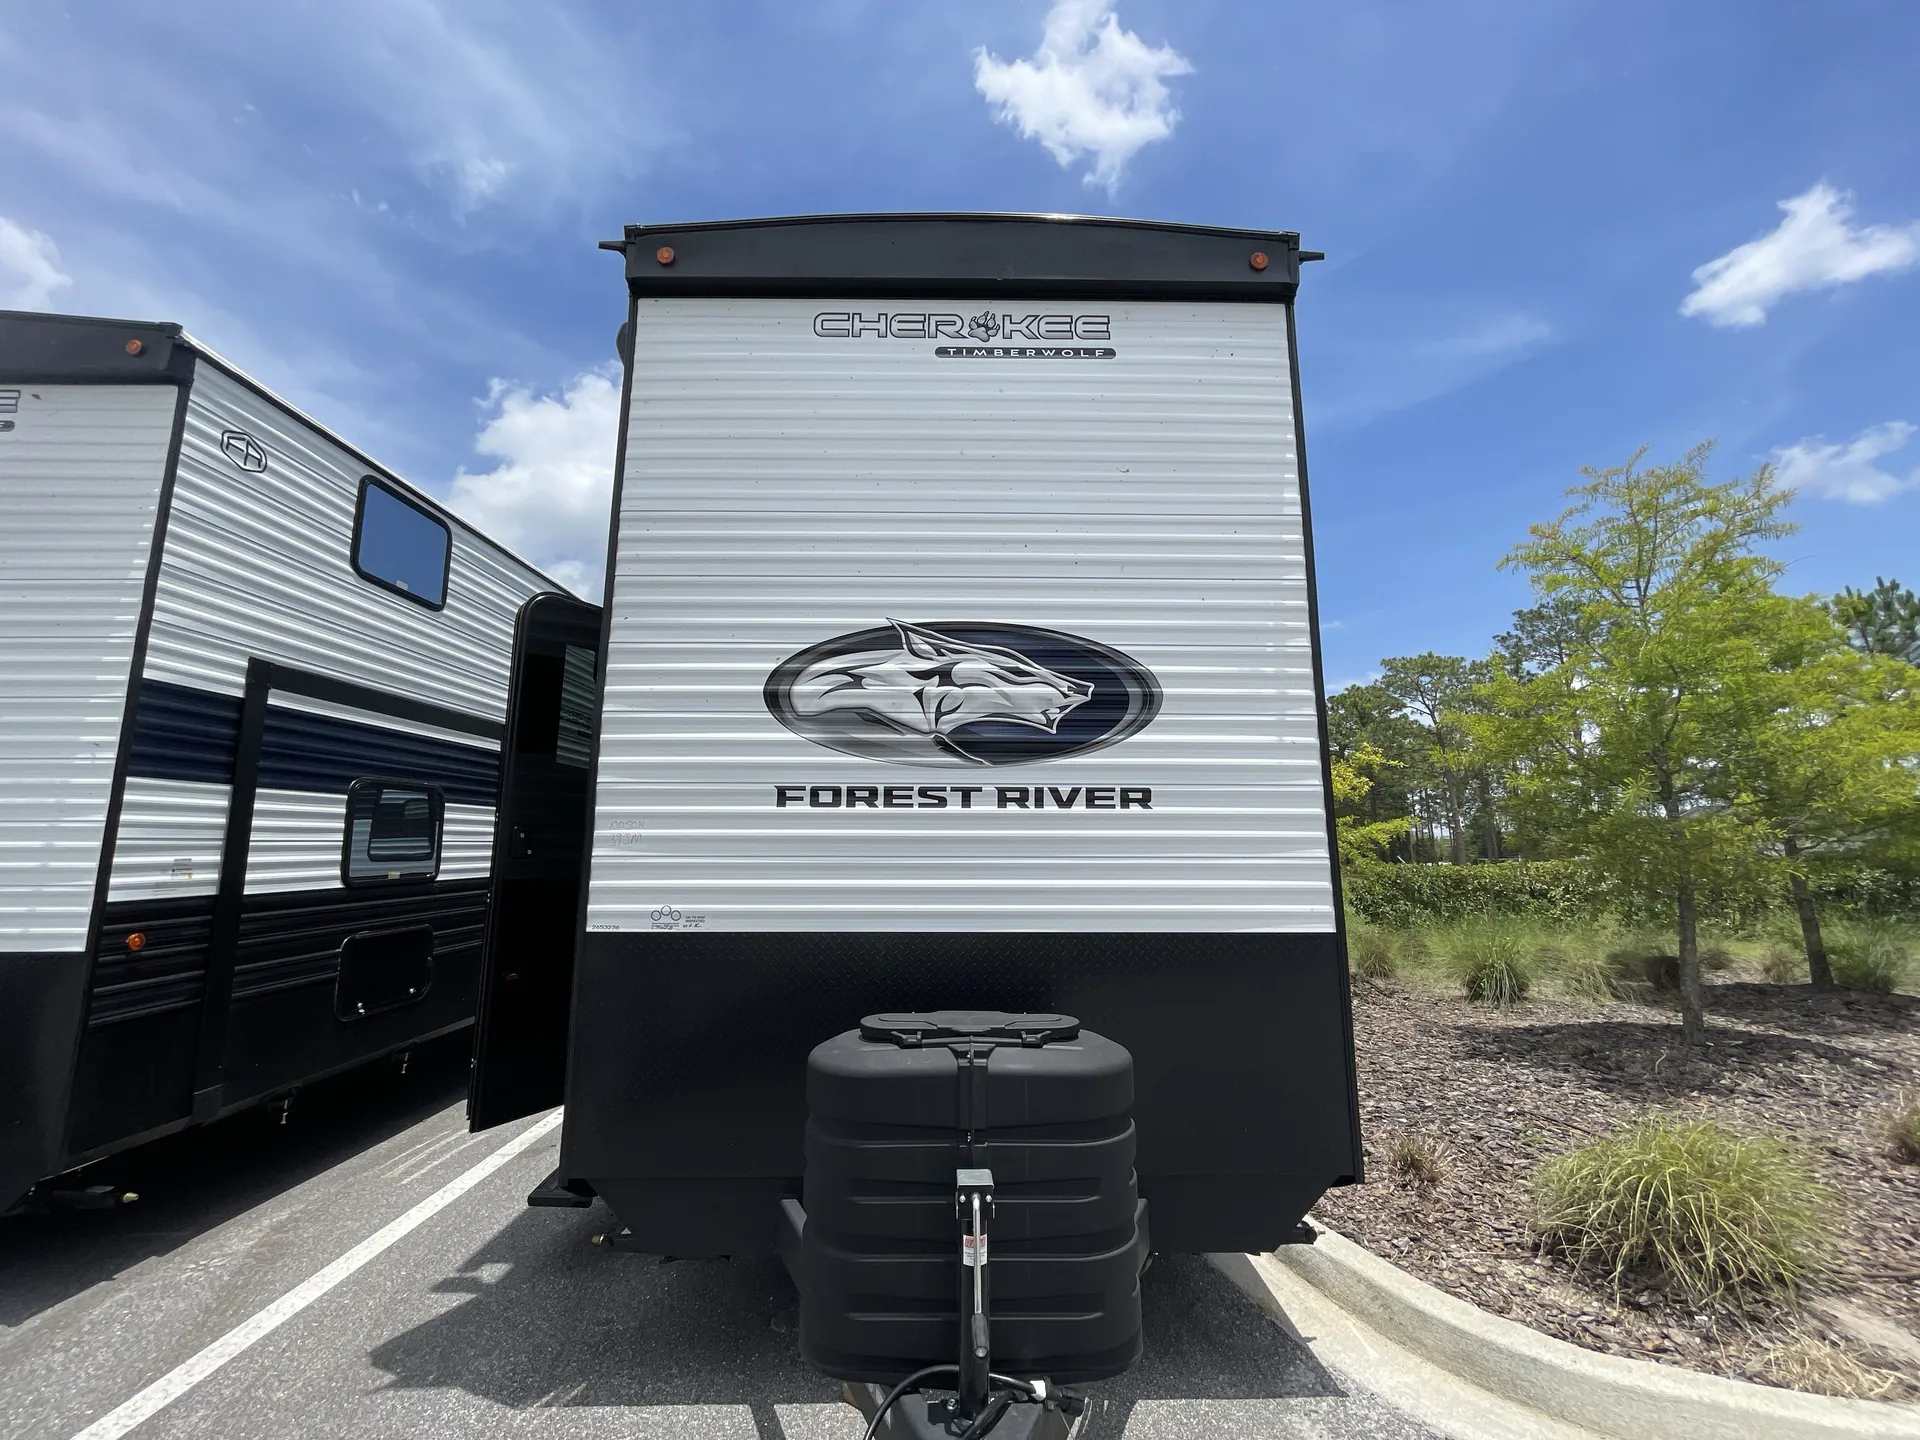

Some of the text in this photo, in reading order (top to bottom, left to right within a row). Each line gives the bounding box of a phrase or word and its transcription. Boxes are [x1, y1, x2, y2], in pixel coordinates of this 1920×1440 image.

[946, 348, 1106, 359] TIMBERWOLF
[773, 785, 1154, 810] FOREST RIVER
